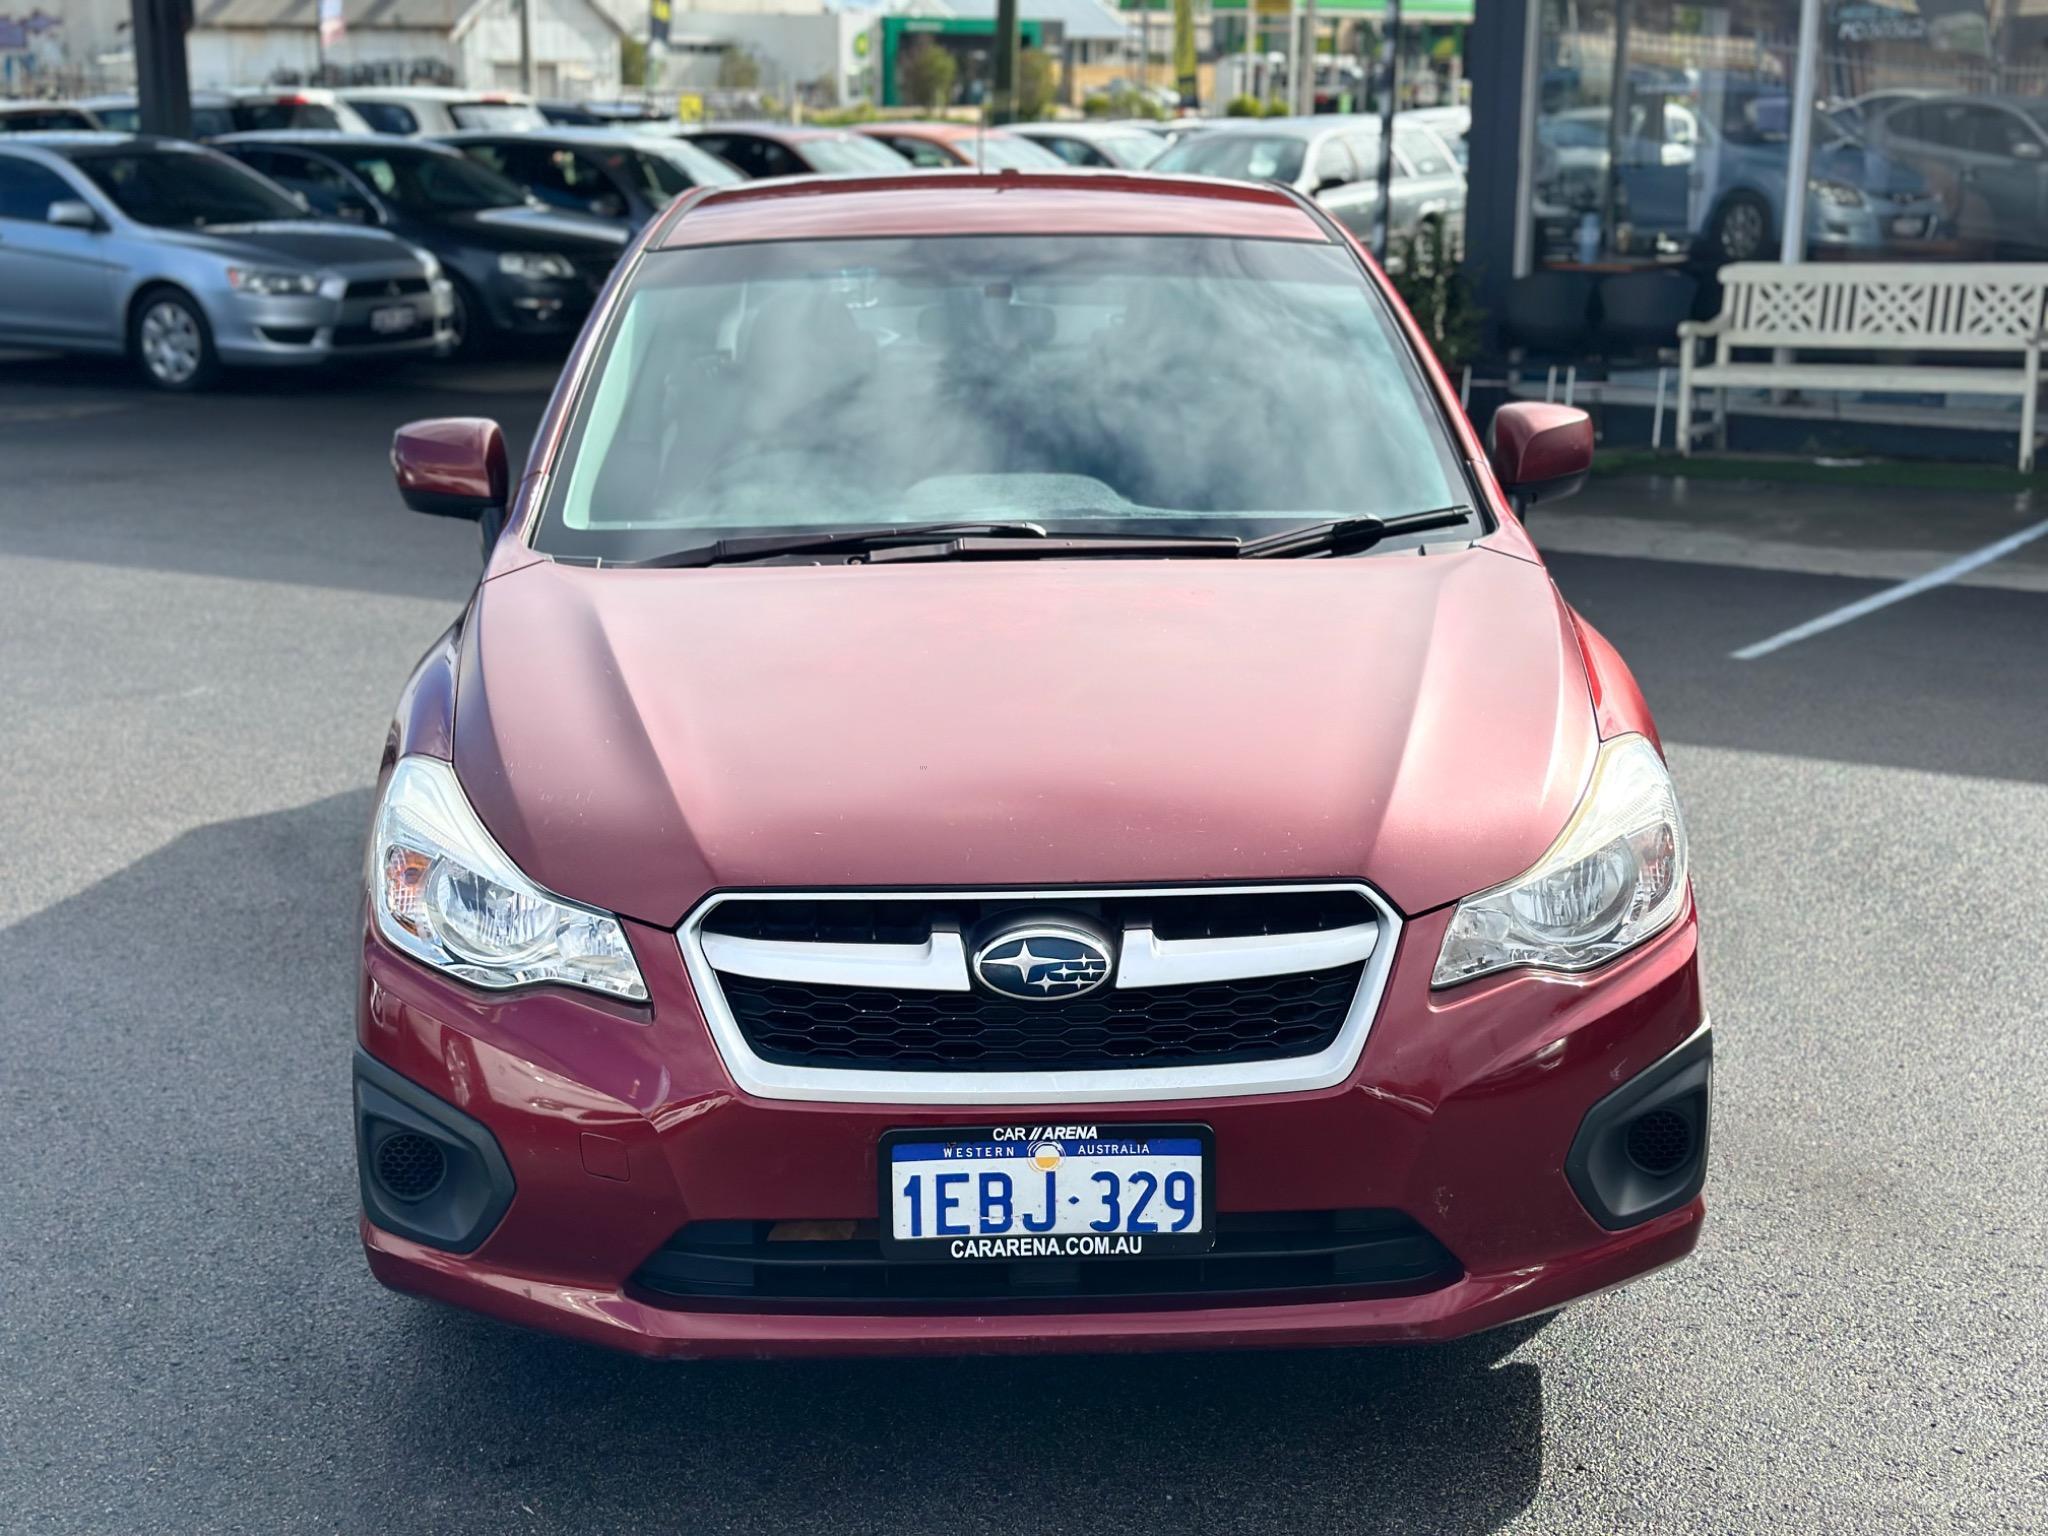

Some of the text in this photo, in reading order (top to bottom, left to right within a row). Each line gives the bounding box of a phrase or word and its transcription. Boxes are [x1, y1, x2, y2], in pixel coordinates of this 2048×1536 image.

[993, 1127, 1026, 1141] CAR
[943, 1143, 1150, 1158] WESTERN AUSTRALIA
[951, 1236, 1143, 1258] CARARENA.COM.AU
